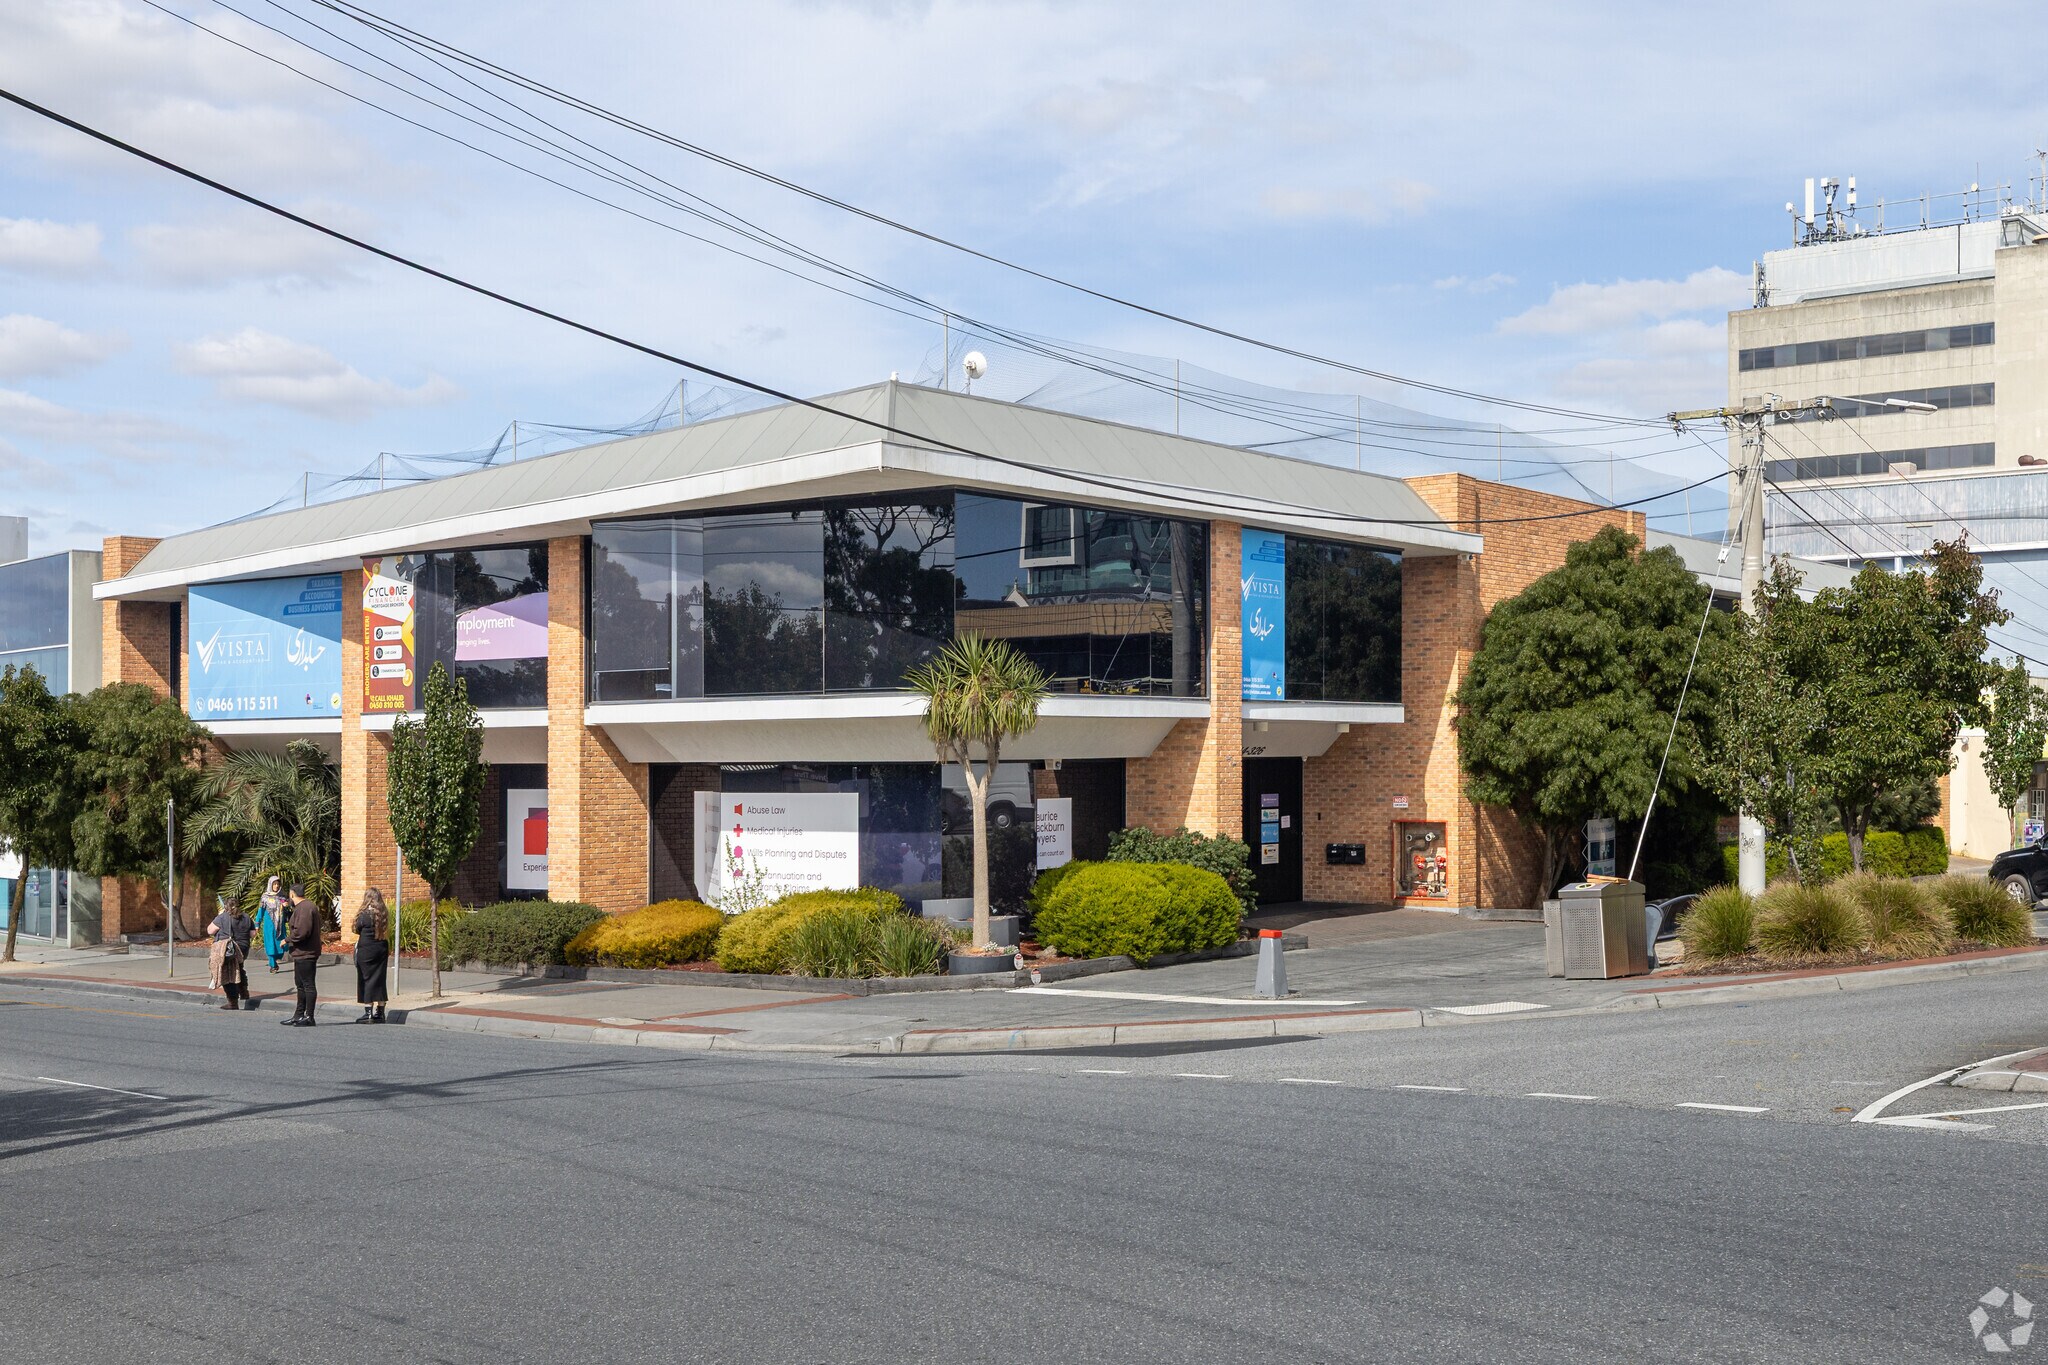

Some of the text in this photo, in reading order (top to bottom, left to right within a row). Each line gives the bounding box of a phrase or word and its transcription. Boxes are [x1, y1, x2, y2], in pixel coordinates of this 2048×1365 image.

[311, 578, 336, 588] TAXATION
[1252, 581, 1280, 595] VISTA
[304, 590, 336, 600] ACCOUNTING
[368, 585, 408, 598] CYCLONE
[368, 596, 408, 604] FINANCIALS
[287, 602, 336, 614] BUSINESS ADVISORY
[217, 640, 265, 657] VISTA
[386, 694, 405, 702] KHALID
[207, 696, 278, 712] 0466 115 511
[369, 701, 405, 709] 0450 810 005
[747, 806, 786, 815] Abuse Law
[747, 826, 803, 838] Medical Injuries
[1036, 822, 1065, 832] ackburn
[747, 849, 847, 861] Wills Planning and Disputes
[746, 871, 822, 881] Suannuation and
